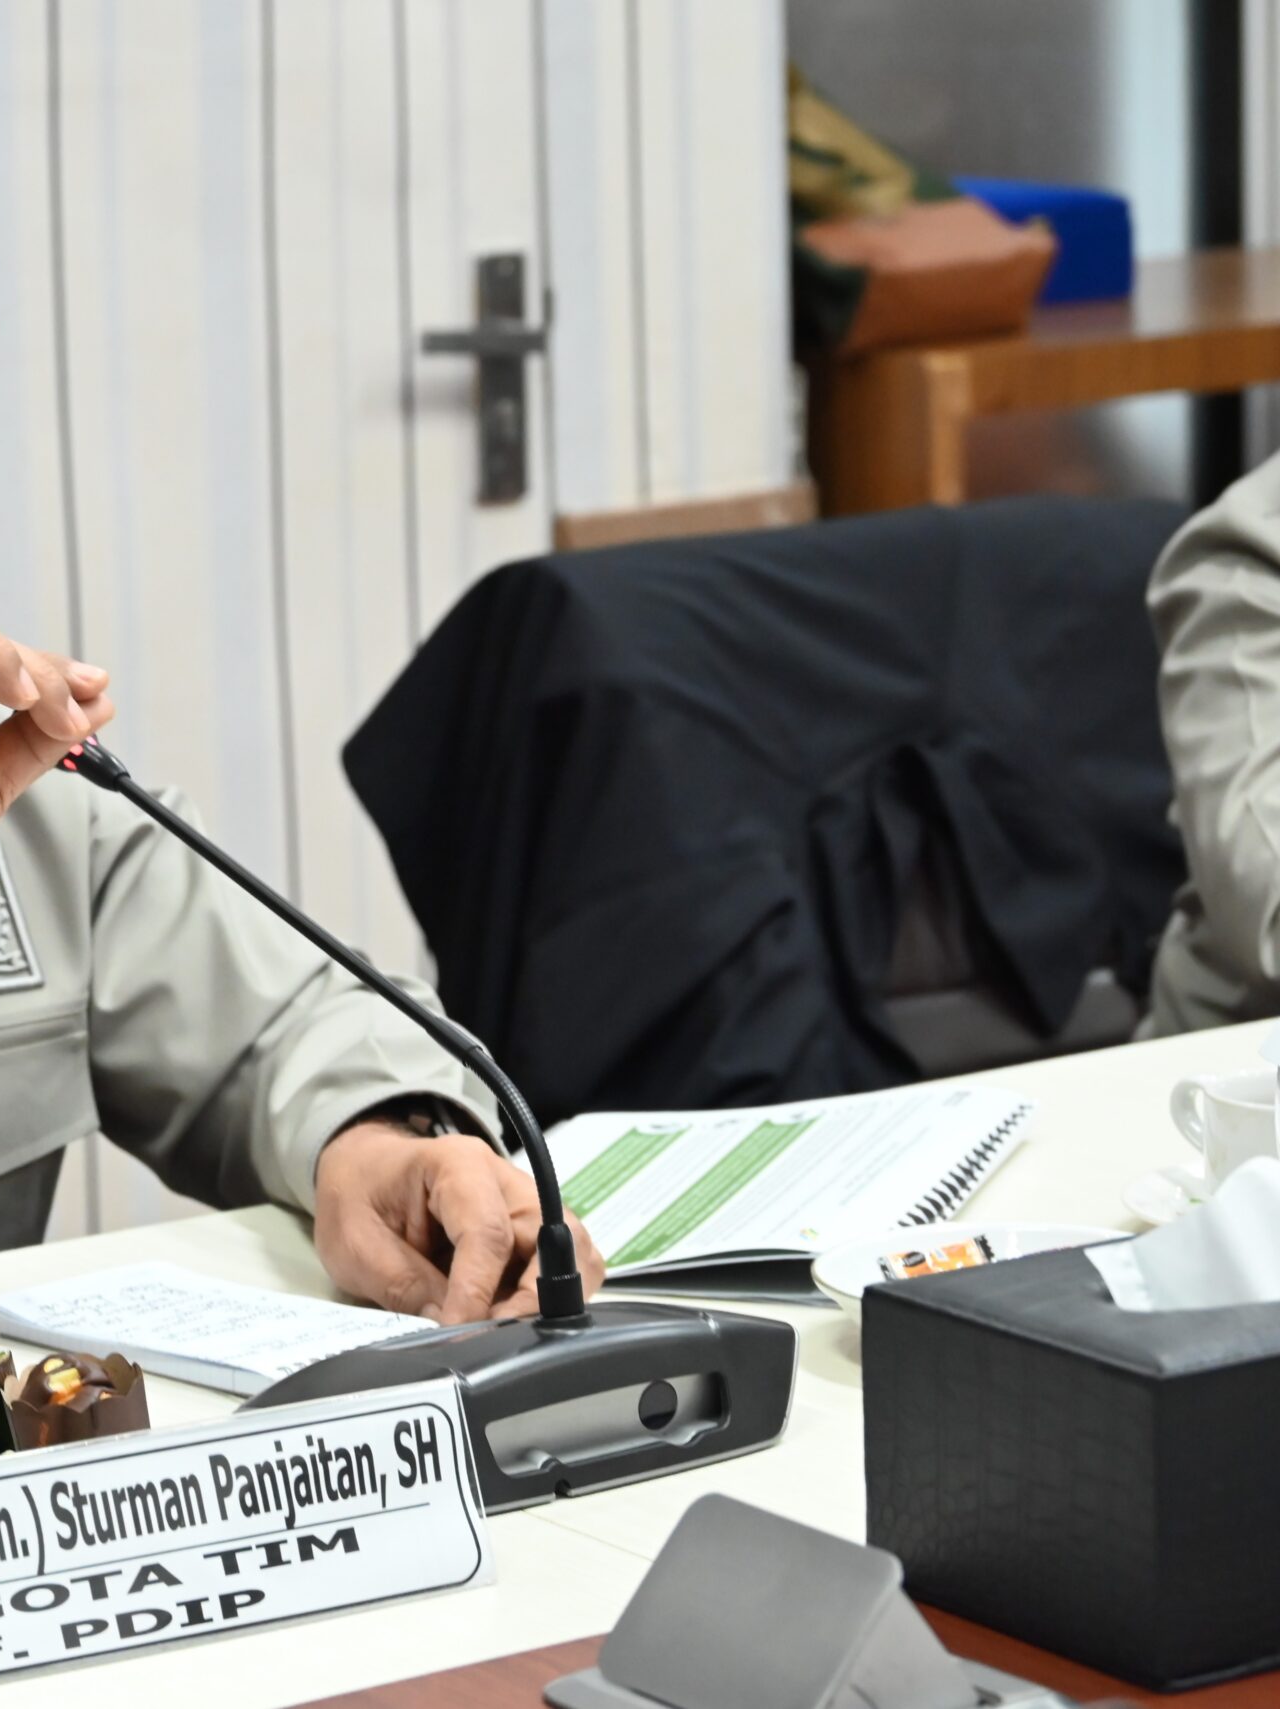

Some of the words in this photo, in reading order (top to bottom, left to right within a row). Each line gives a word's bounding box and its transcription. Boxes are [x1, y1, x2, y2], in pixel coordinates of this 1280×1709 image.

[50, 1471, 208, 1551] Sturman
[208, 1434, 388, 1529] Panjaitan,
[393, 1416, 443, 1489] SH
[203, 1527, 360, 1577] TIM
[60, 1588, 266, 1650] PDIP
